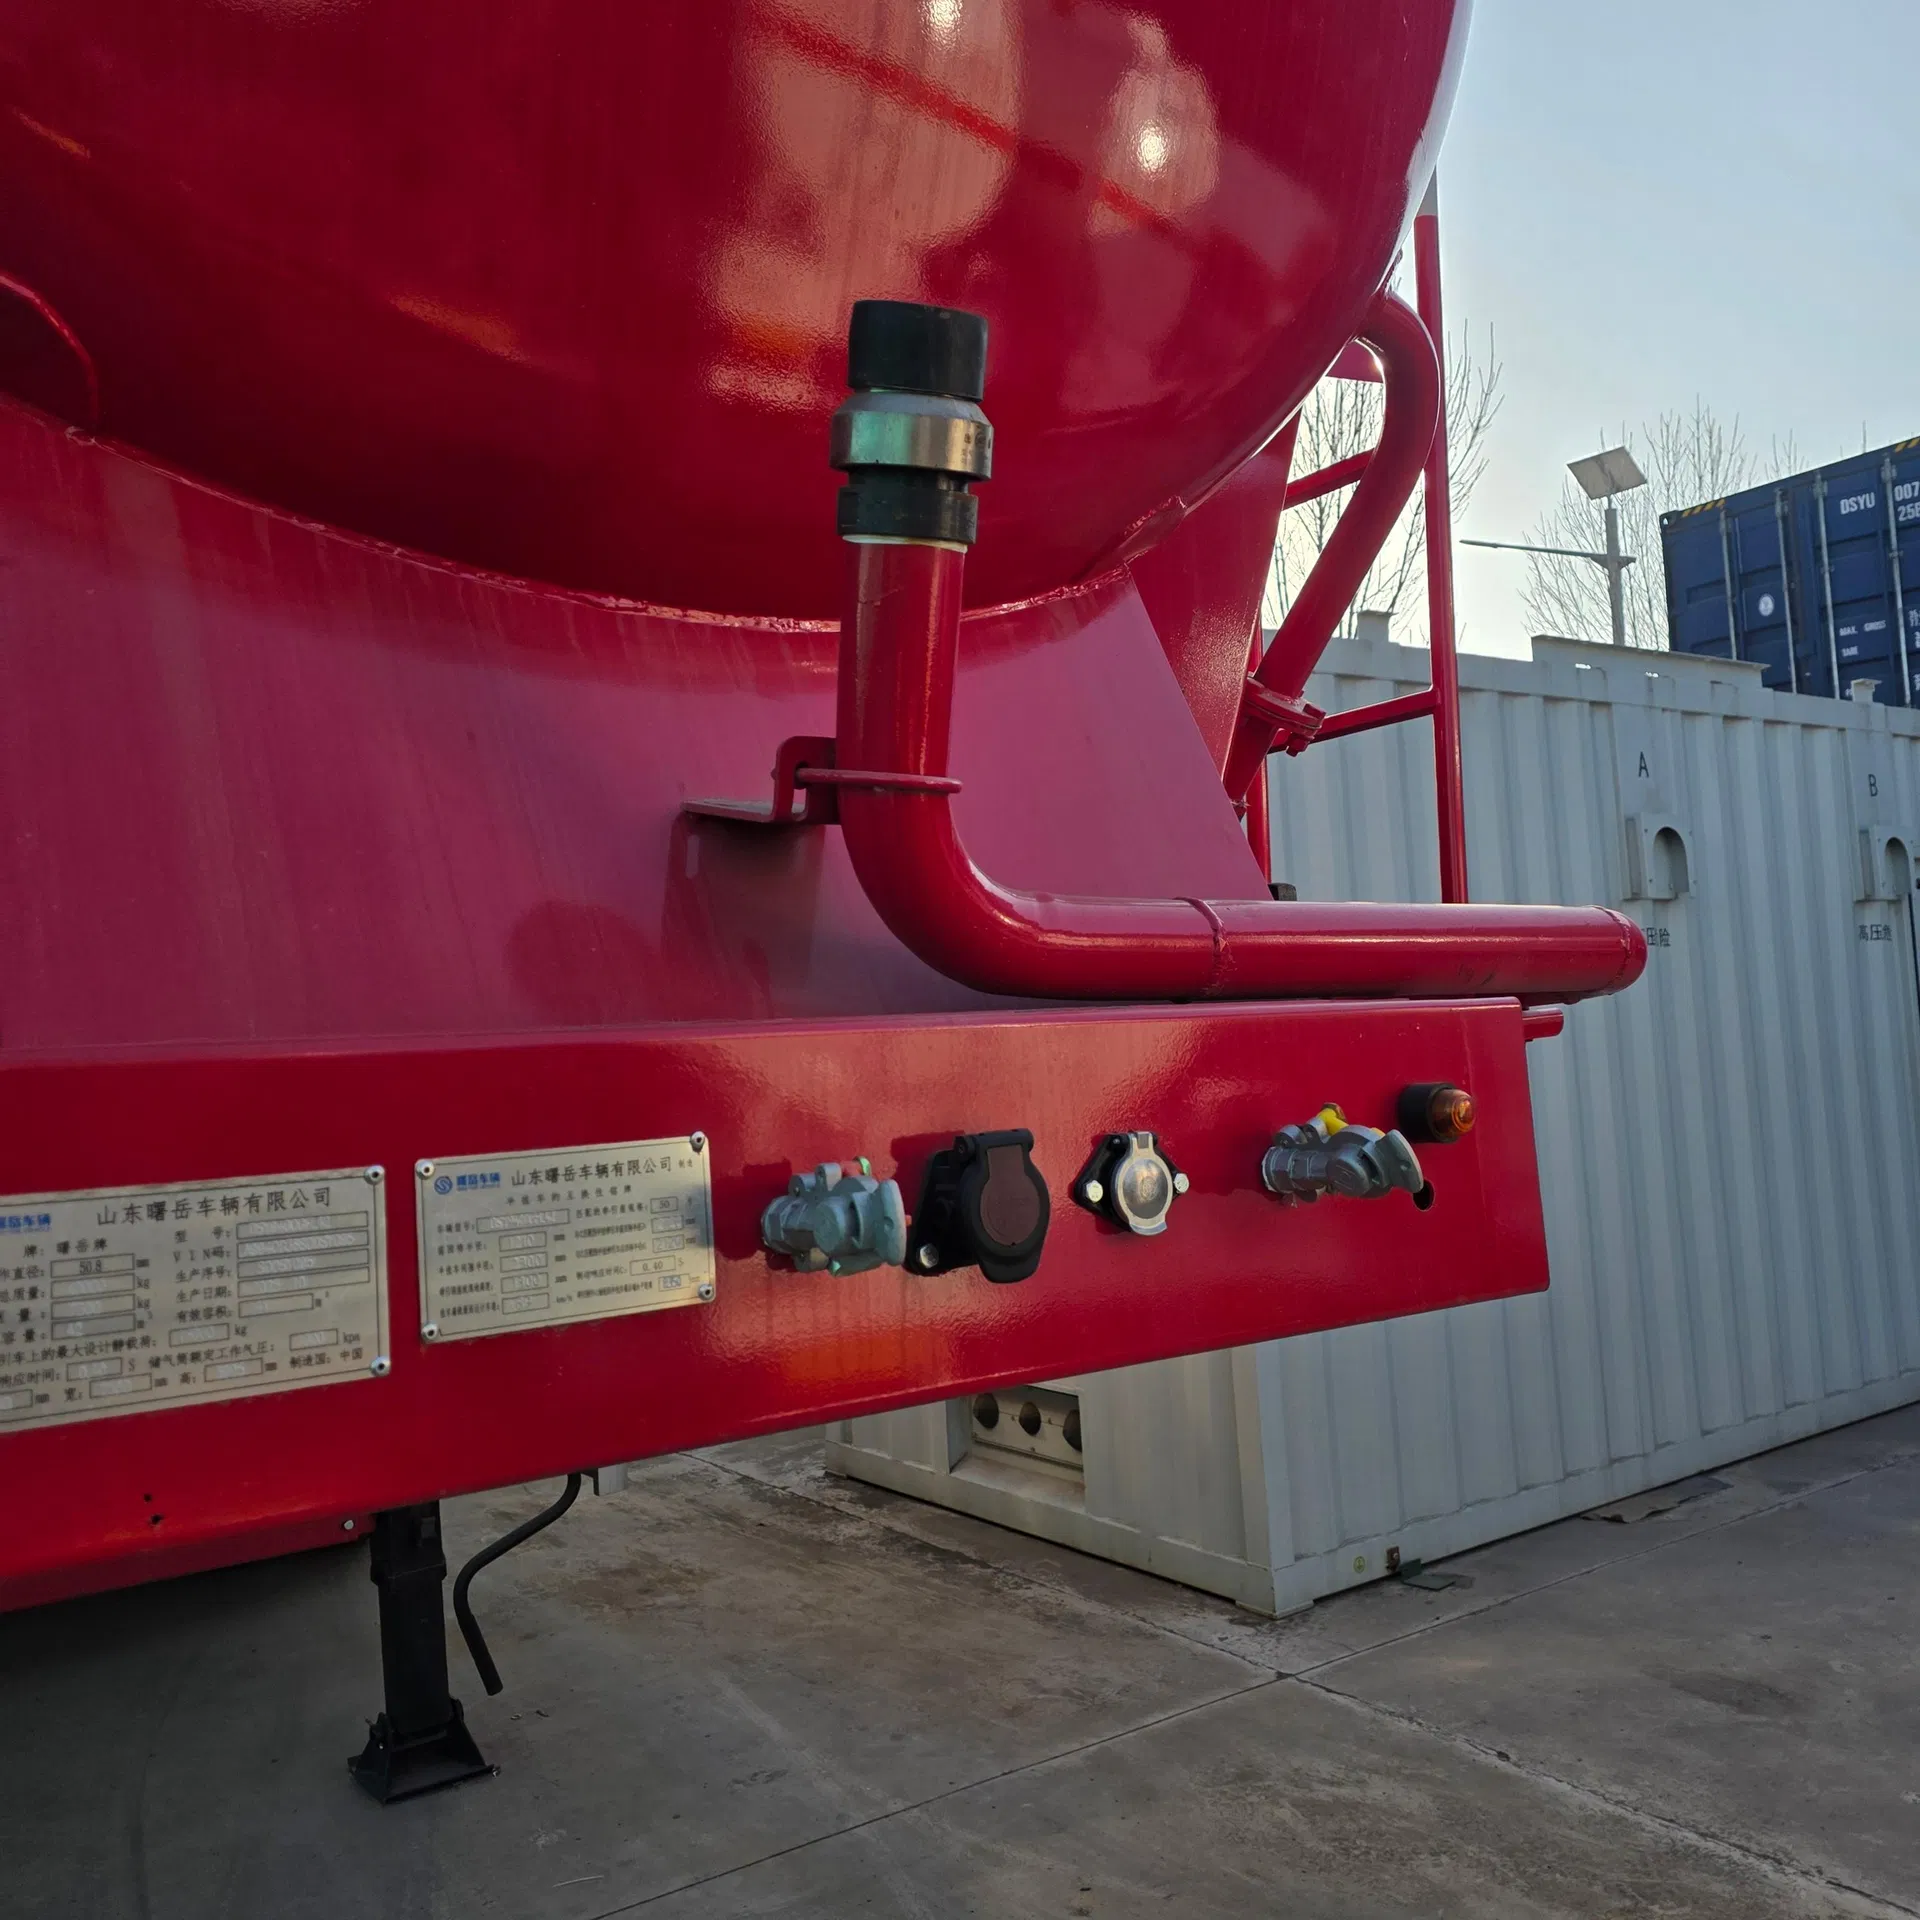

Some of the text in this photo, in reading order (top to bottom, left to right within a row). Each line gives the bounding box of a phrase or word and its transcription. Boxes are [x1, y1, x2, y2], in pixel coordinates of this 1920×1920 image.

[1638, 751, 1649, 778] A
[1867, 774, 1878, 797] B
[511, 1156, 672, 1187] 山东曙岳车辆有限公司
[97, 1186, 330, 1226] 山东曙岳车辆有限公司
